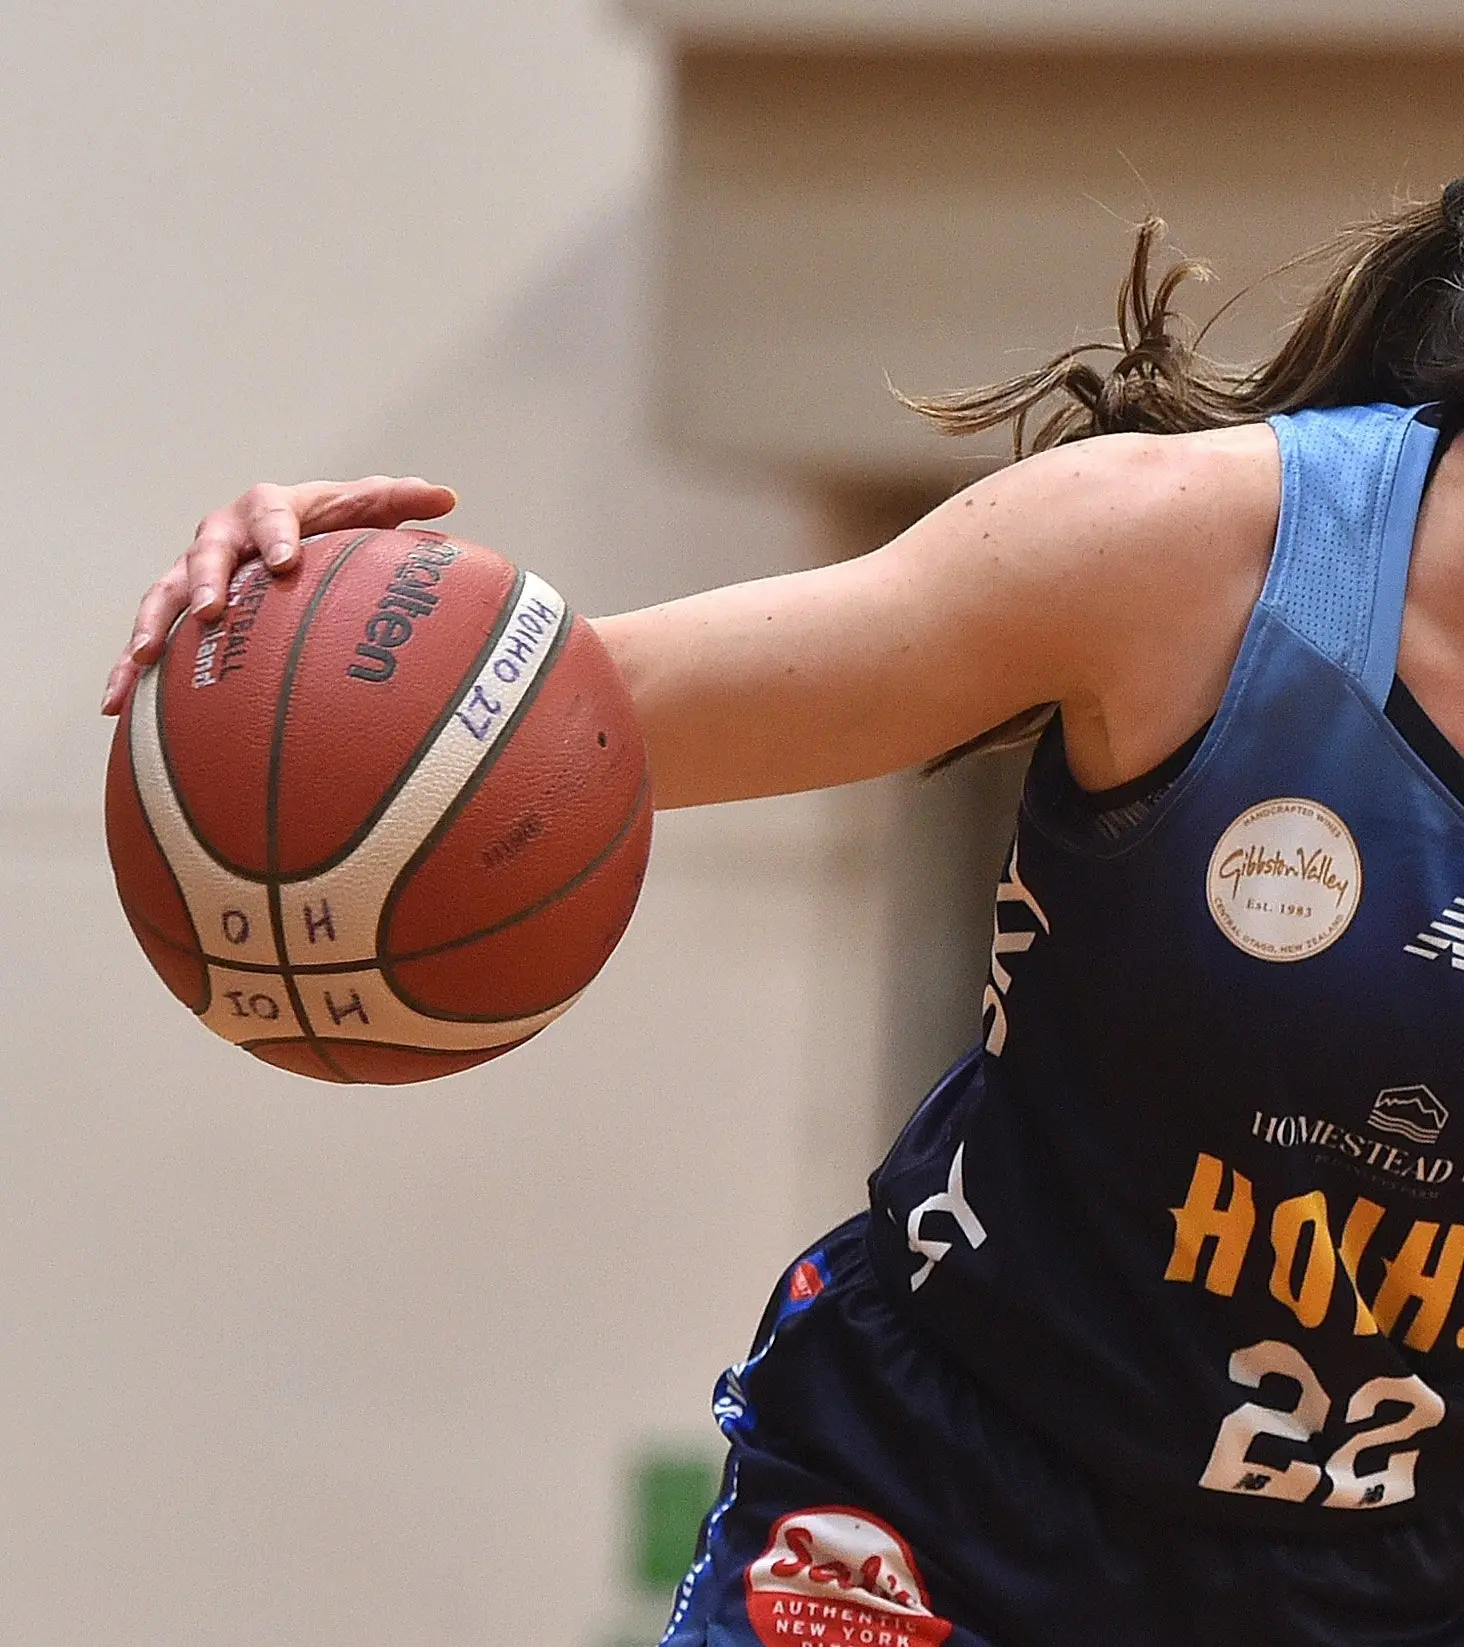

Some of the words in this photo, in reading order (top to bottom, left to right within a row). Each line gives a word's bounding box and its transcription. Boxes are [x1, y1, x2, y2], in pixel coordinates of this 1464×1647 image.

[346, 537, 462, 683] molten
[493, 598, 558, 684] HOIHO
[455, 685, 502, 742] 27
[1243, 804, 1315, 828] HANDCRAFTED
[1316, 810, 1343, 839] WINES
[1219, 844, 1298, 900] Gibbston
[1297, 846, 1349, 909] Valley
[1214, 897, 1241, 938] CENTRAL
[1306, 913, 1345, 949] ZEALAND
[1246, 898, 1273, 913] Est.
[1278, 903, 1313, 918] 1983
[1251, 1110, 1454, 1184] HOMESTEAD
[1199, 1339, 1446, 1510] 22
[772, 1599, 919, 1633] AUTHENTIC
[776, 1620, 827, 1638] NEW
[842, 1626, 911, 1647] YORK
